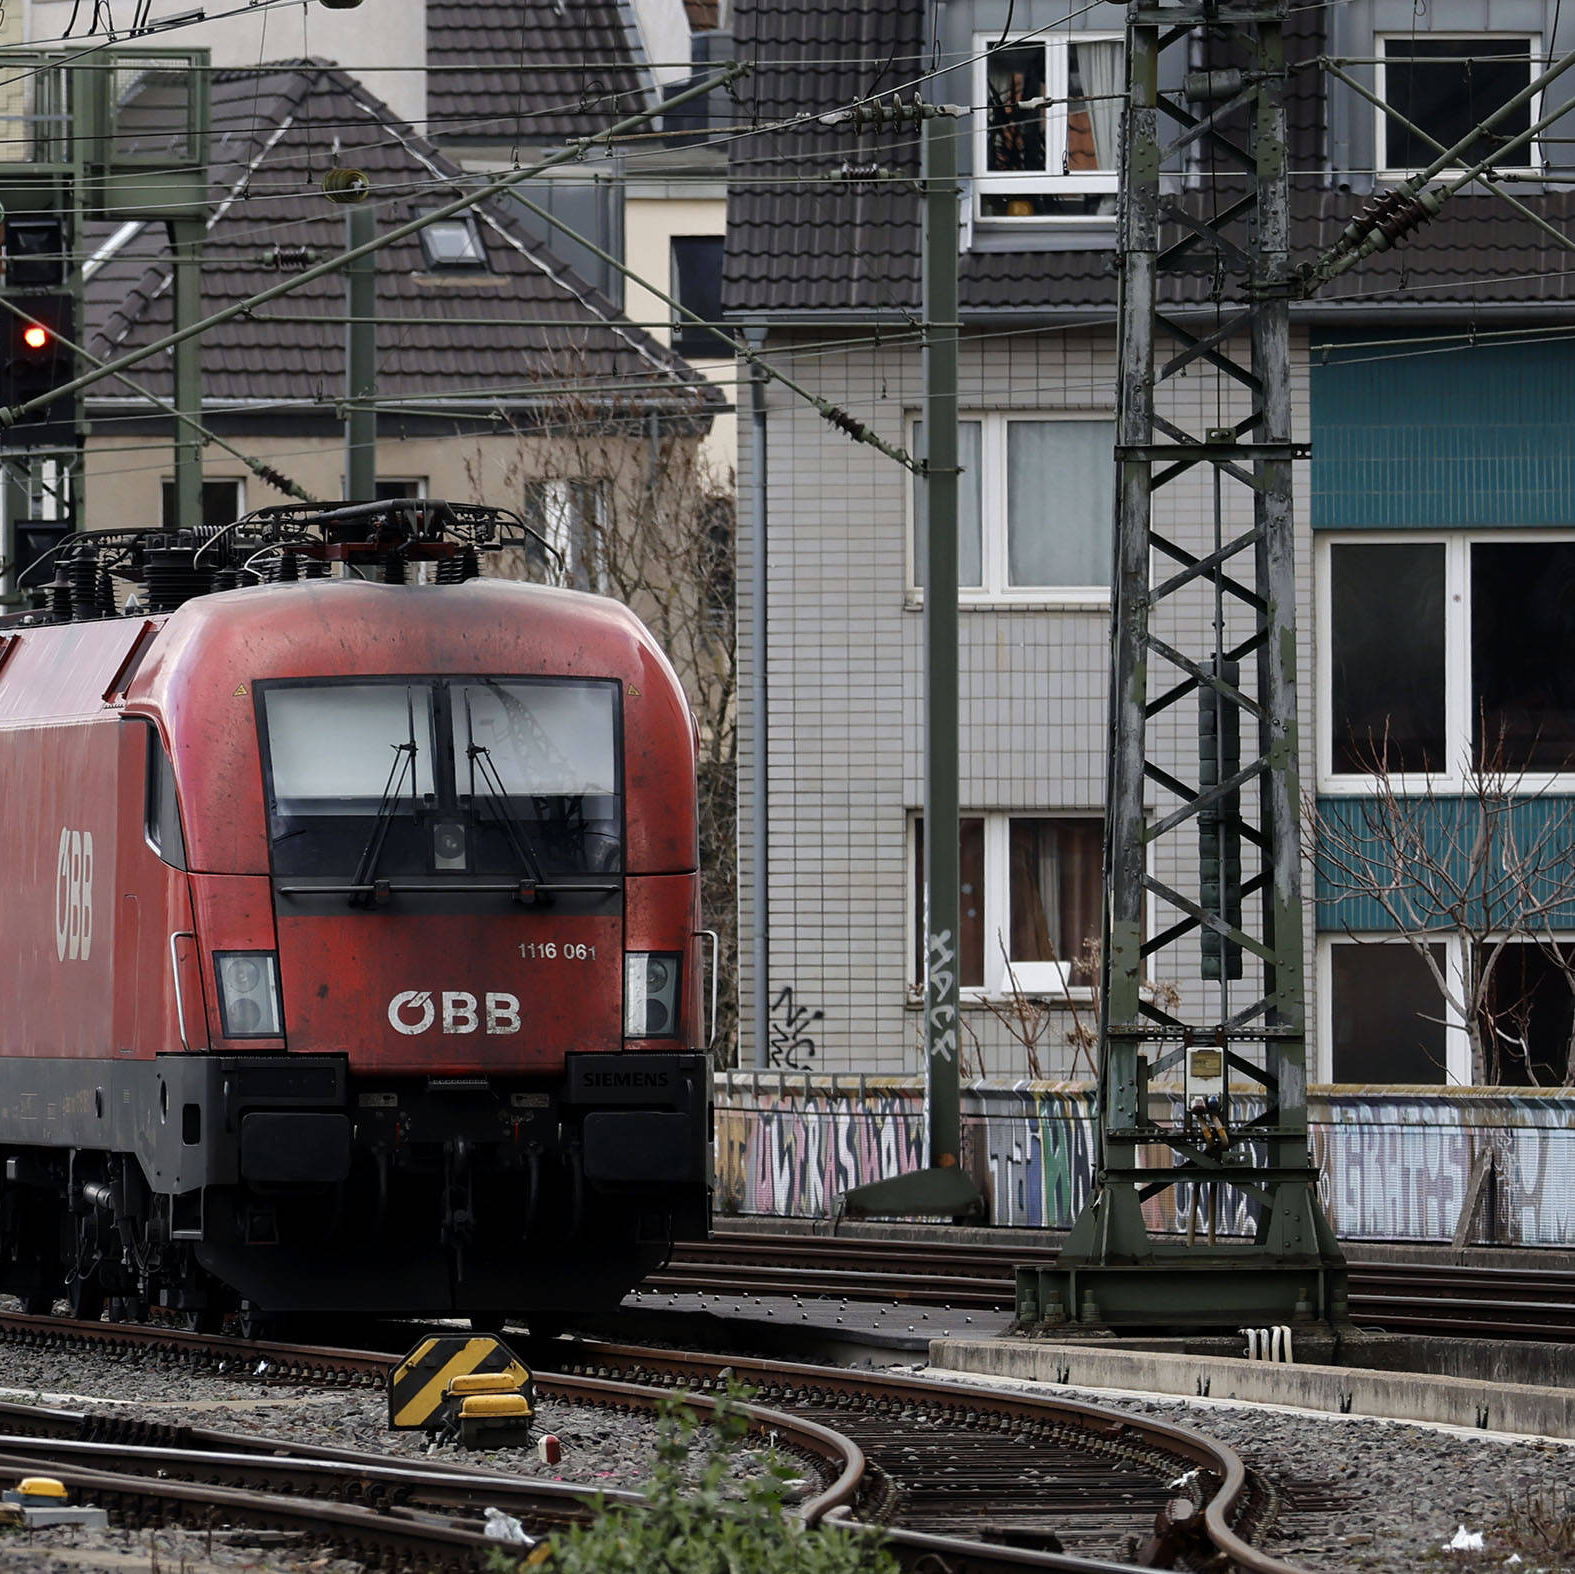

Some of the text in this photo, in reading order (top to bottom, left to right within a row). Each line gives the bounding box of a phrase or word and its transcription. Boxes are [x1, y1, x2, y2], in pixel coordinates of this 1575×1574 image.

[518, 942, 597, 960] 1116 061
[387, 990, 522, 1035] ÖBB
[582, 1072, 669, 1088] SIEMENS
